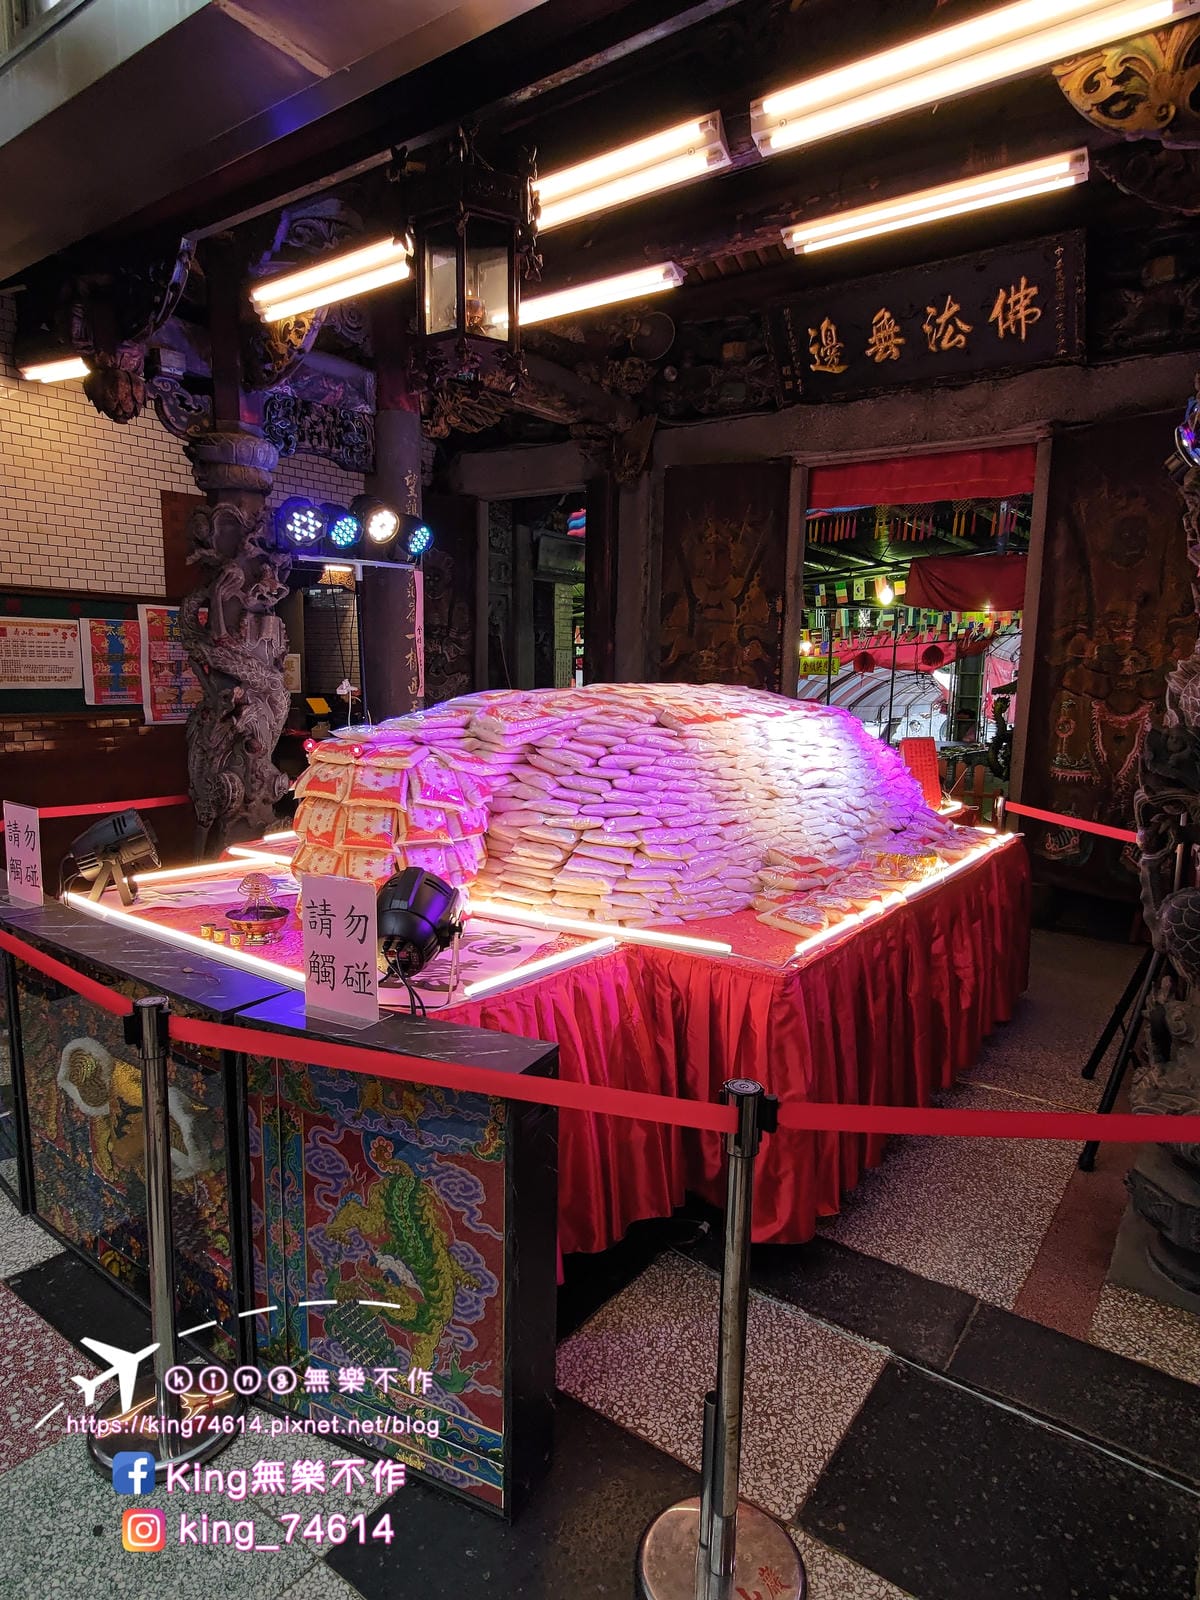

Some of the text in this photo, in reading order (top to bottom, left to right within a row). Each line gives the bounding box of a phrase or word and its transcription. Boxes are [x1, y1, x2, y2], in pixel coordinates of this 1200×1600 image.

[808, 275, 1042, 374] 佛法無邊
[7, 820, 36, 852] 請勿
[10, 857, 40, 888] 觸碰
[305, 898, 369, 945] 請勿
[308, 950, 375, 996] 觸碰
